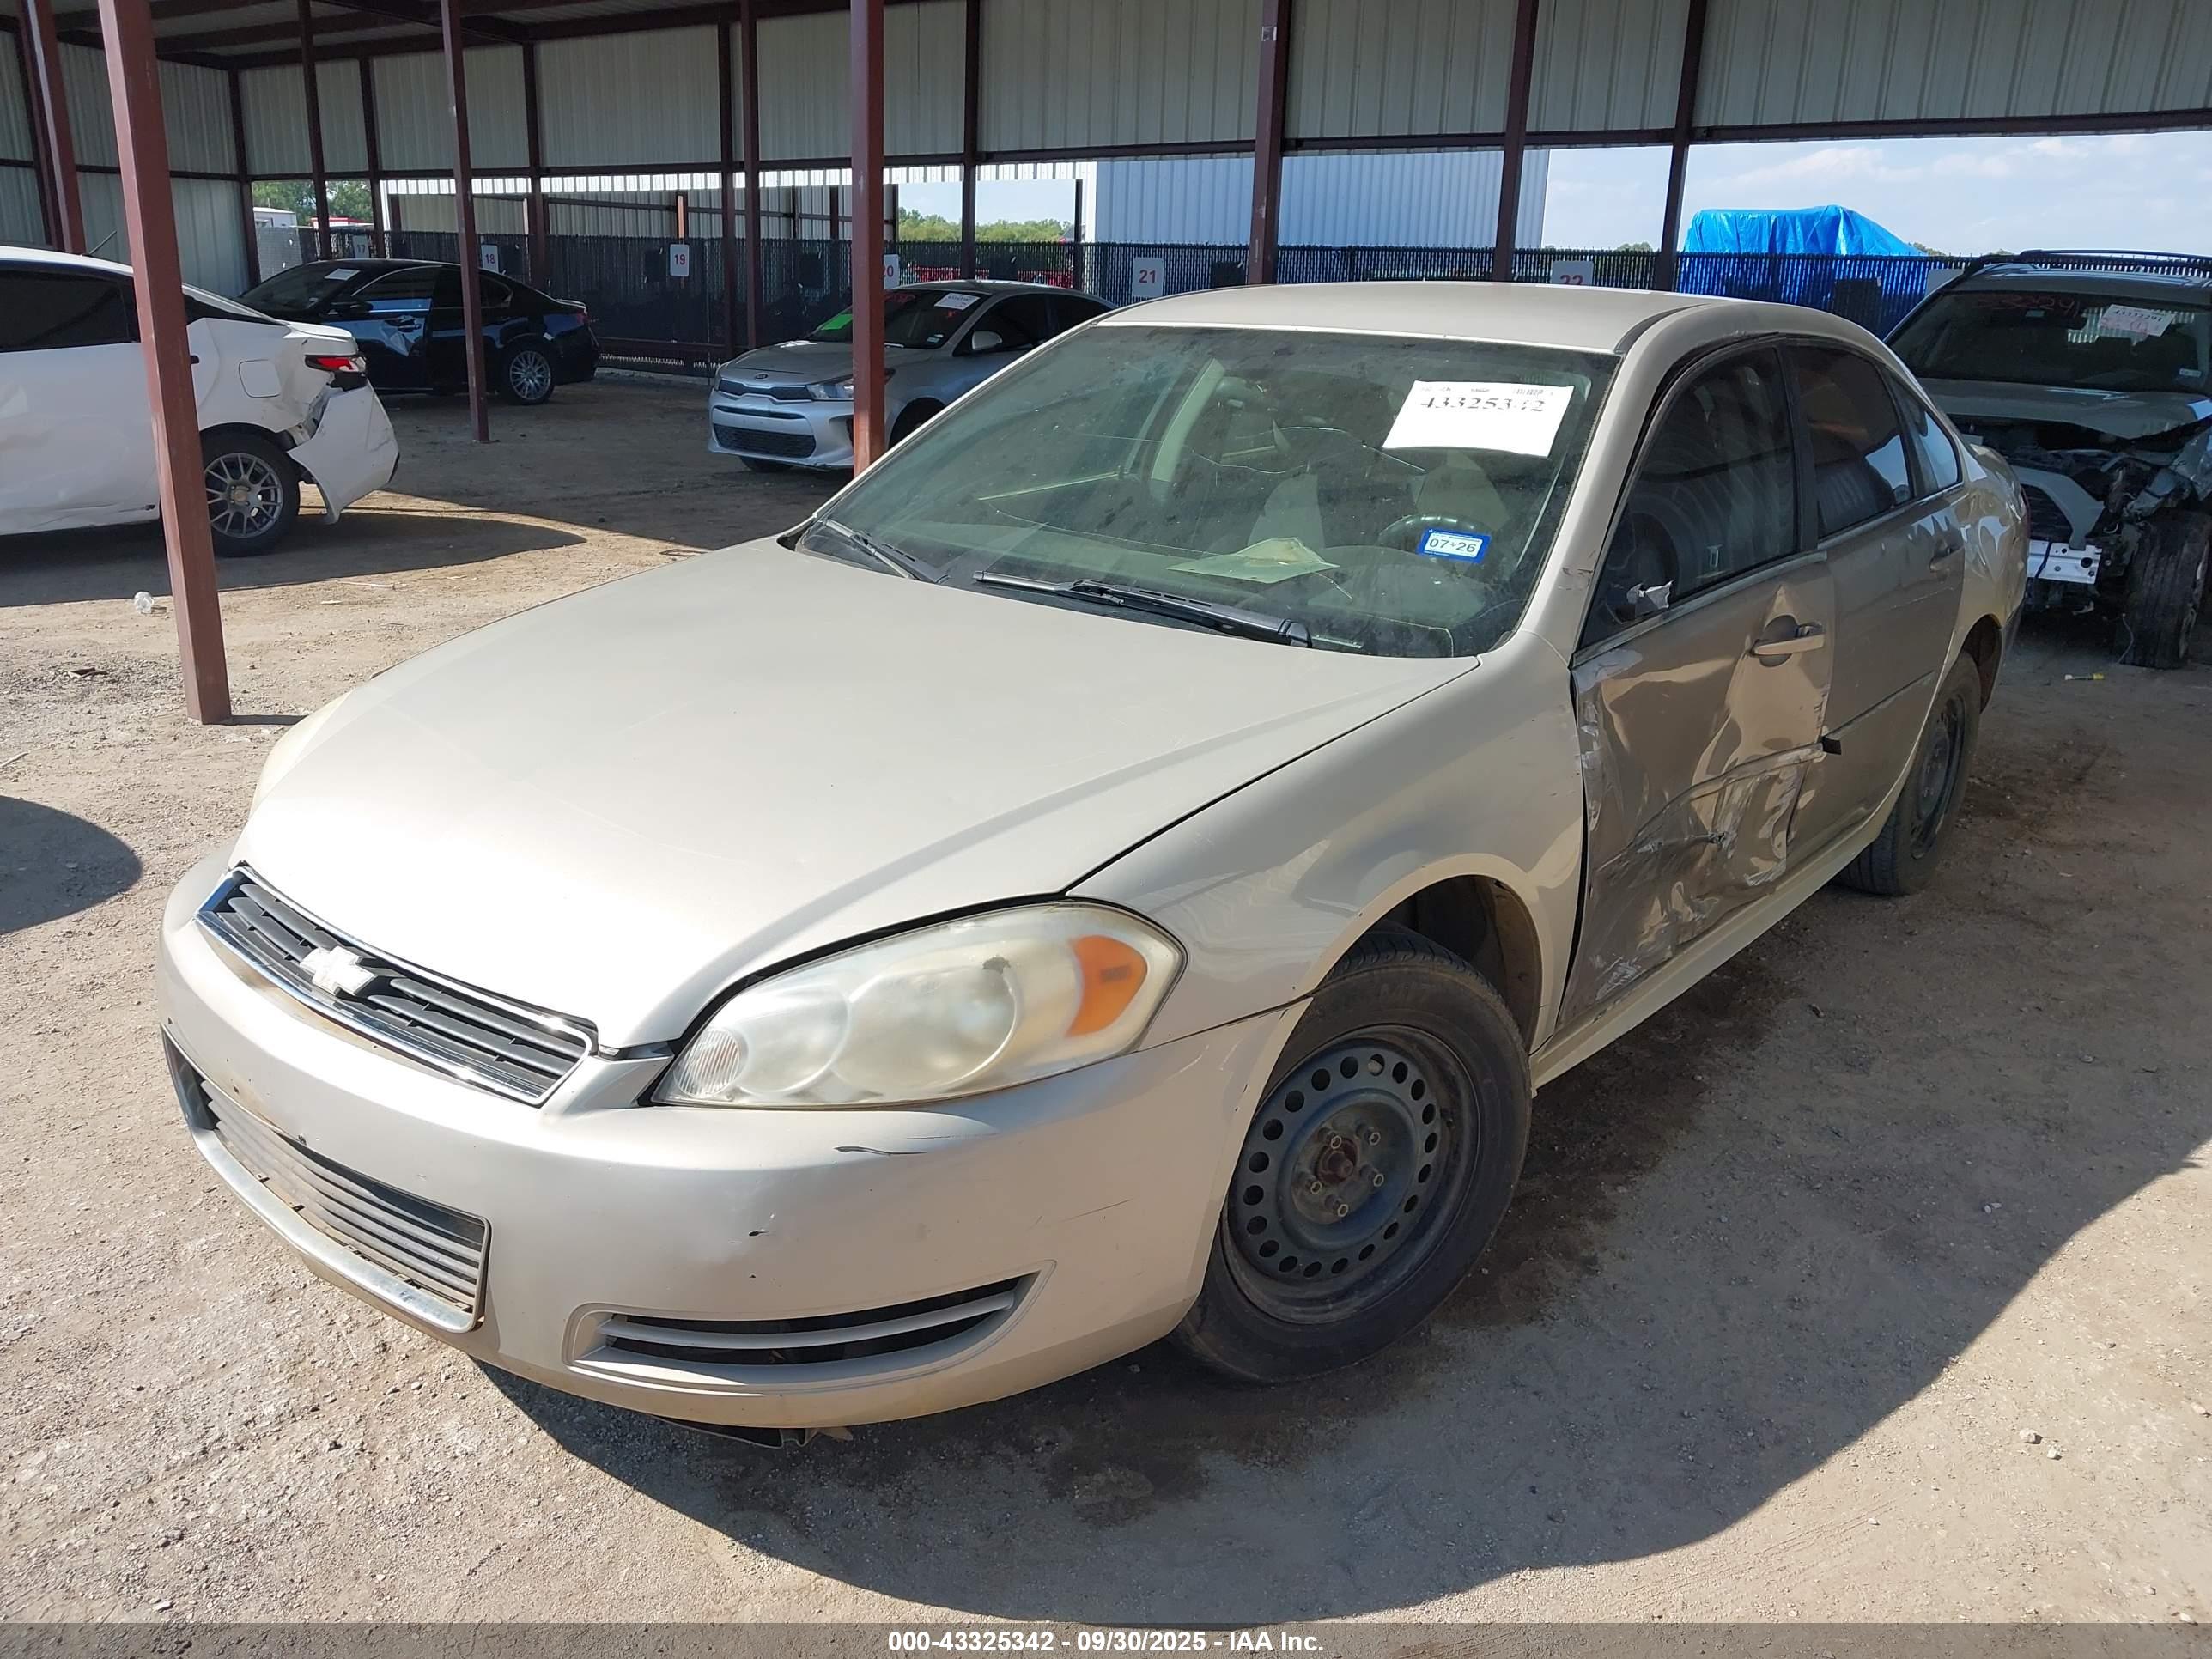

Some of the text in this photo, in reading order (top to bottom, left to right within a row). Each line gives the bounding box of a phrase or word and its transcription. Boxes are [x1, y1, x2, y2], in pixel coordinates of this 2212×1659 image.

[485, 253, 495, 264] 18
[674, 253, 686, 265] 19
[1139, 269, 1156, 283] 21
